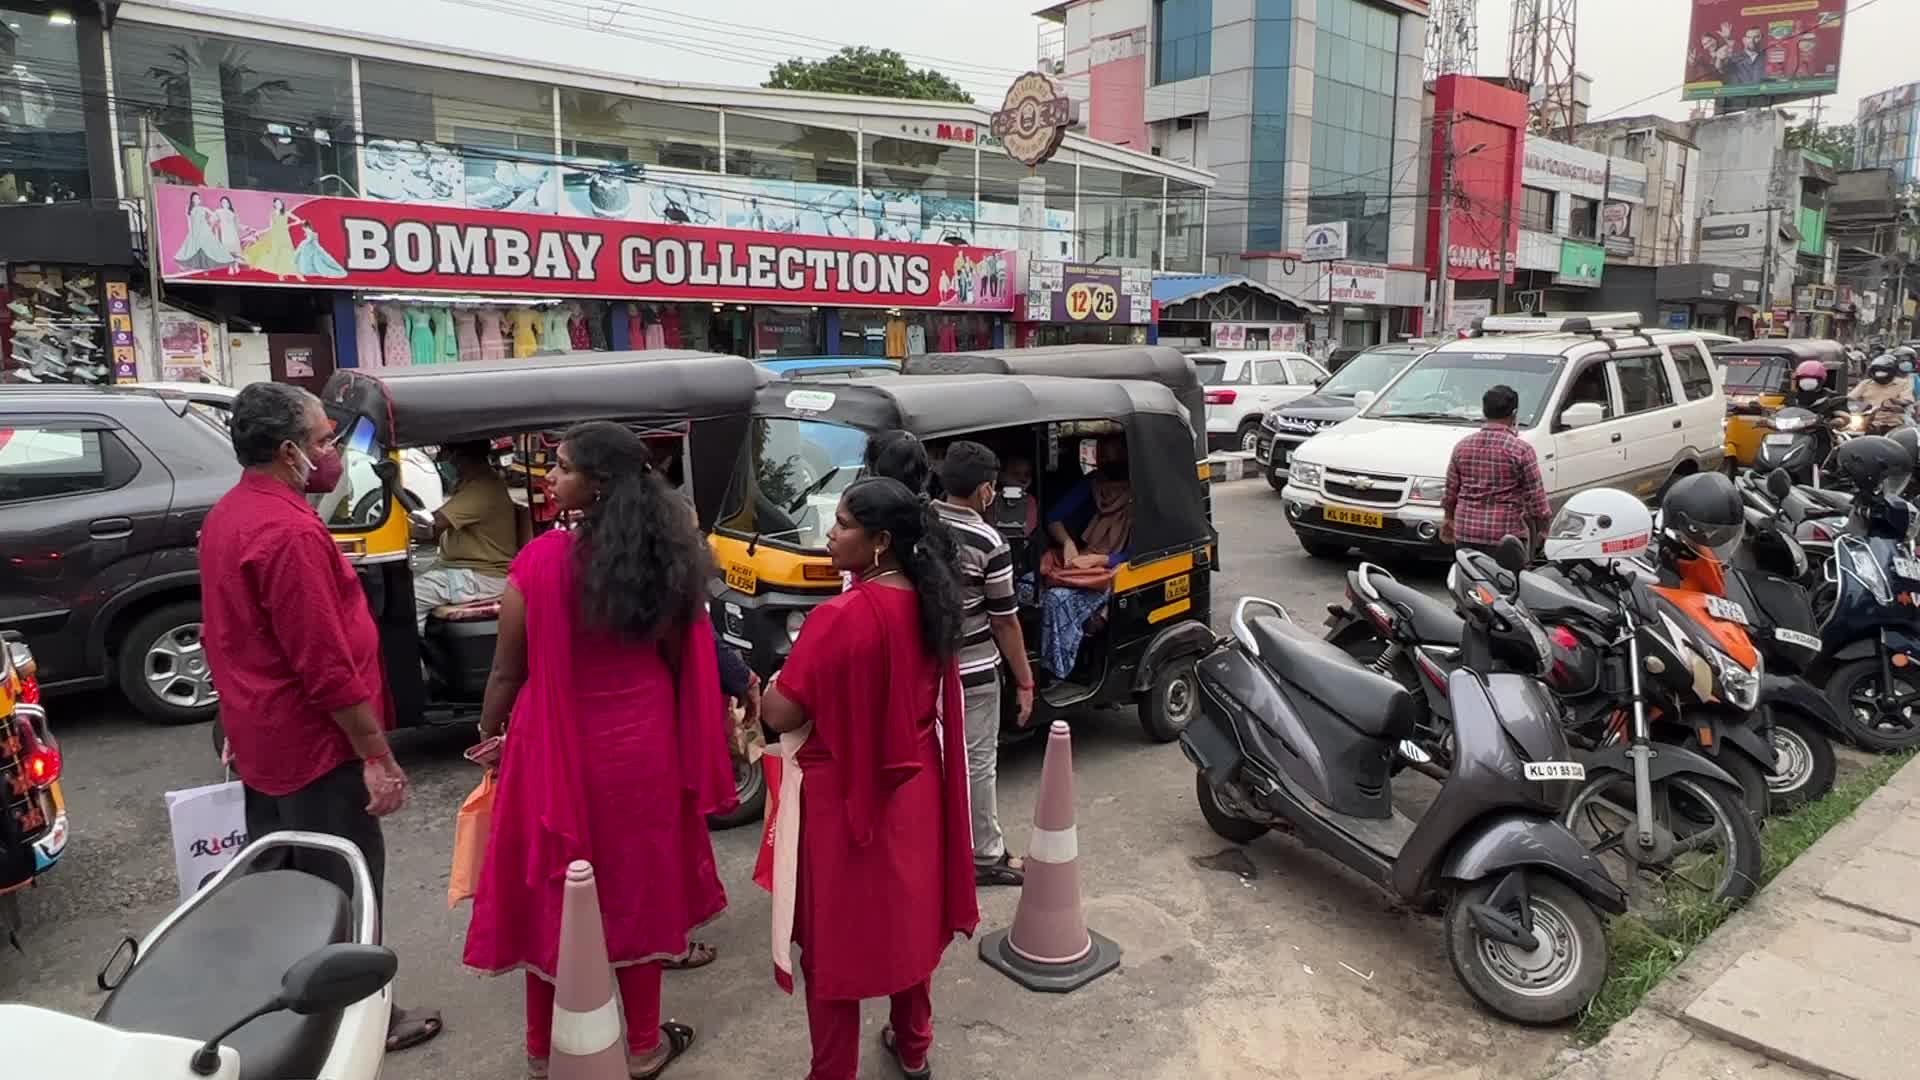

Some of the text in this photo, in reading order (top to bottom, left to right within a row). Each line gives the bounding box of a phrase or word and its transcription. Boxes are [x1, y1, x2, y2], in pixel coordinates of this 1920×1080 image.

[937, 124, 974, 143] MAS
[344, 217, 930, 296] BOMBAY COLLECTIONS
[1322, 263, 1384, 279] NATIONAL HOSPITAL
[1071, 291, 1114, 313] 12 25
[1354, 290, 1376, 300] CLINIC
[1364, 513, 1378, 526] 504
[1529, 765, 1545, 777] KL
[1546, 765, 1558, 777] 01
